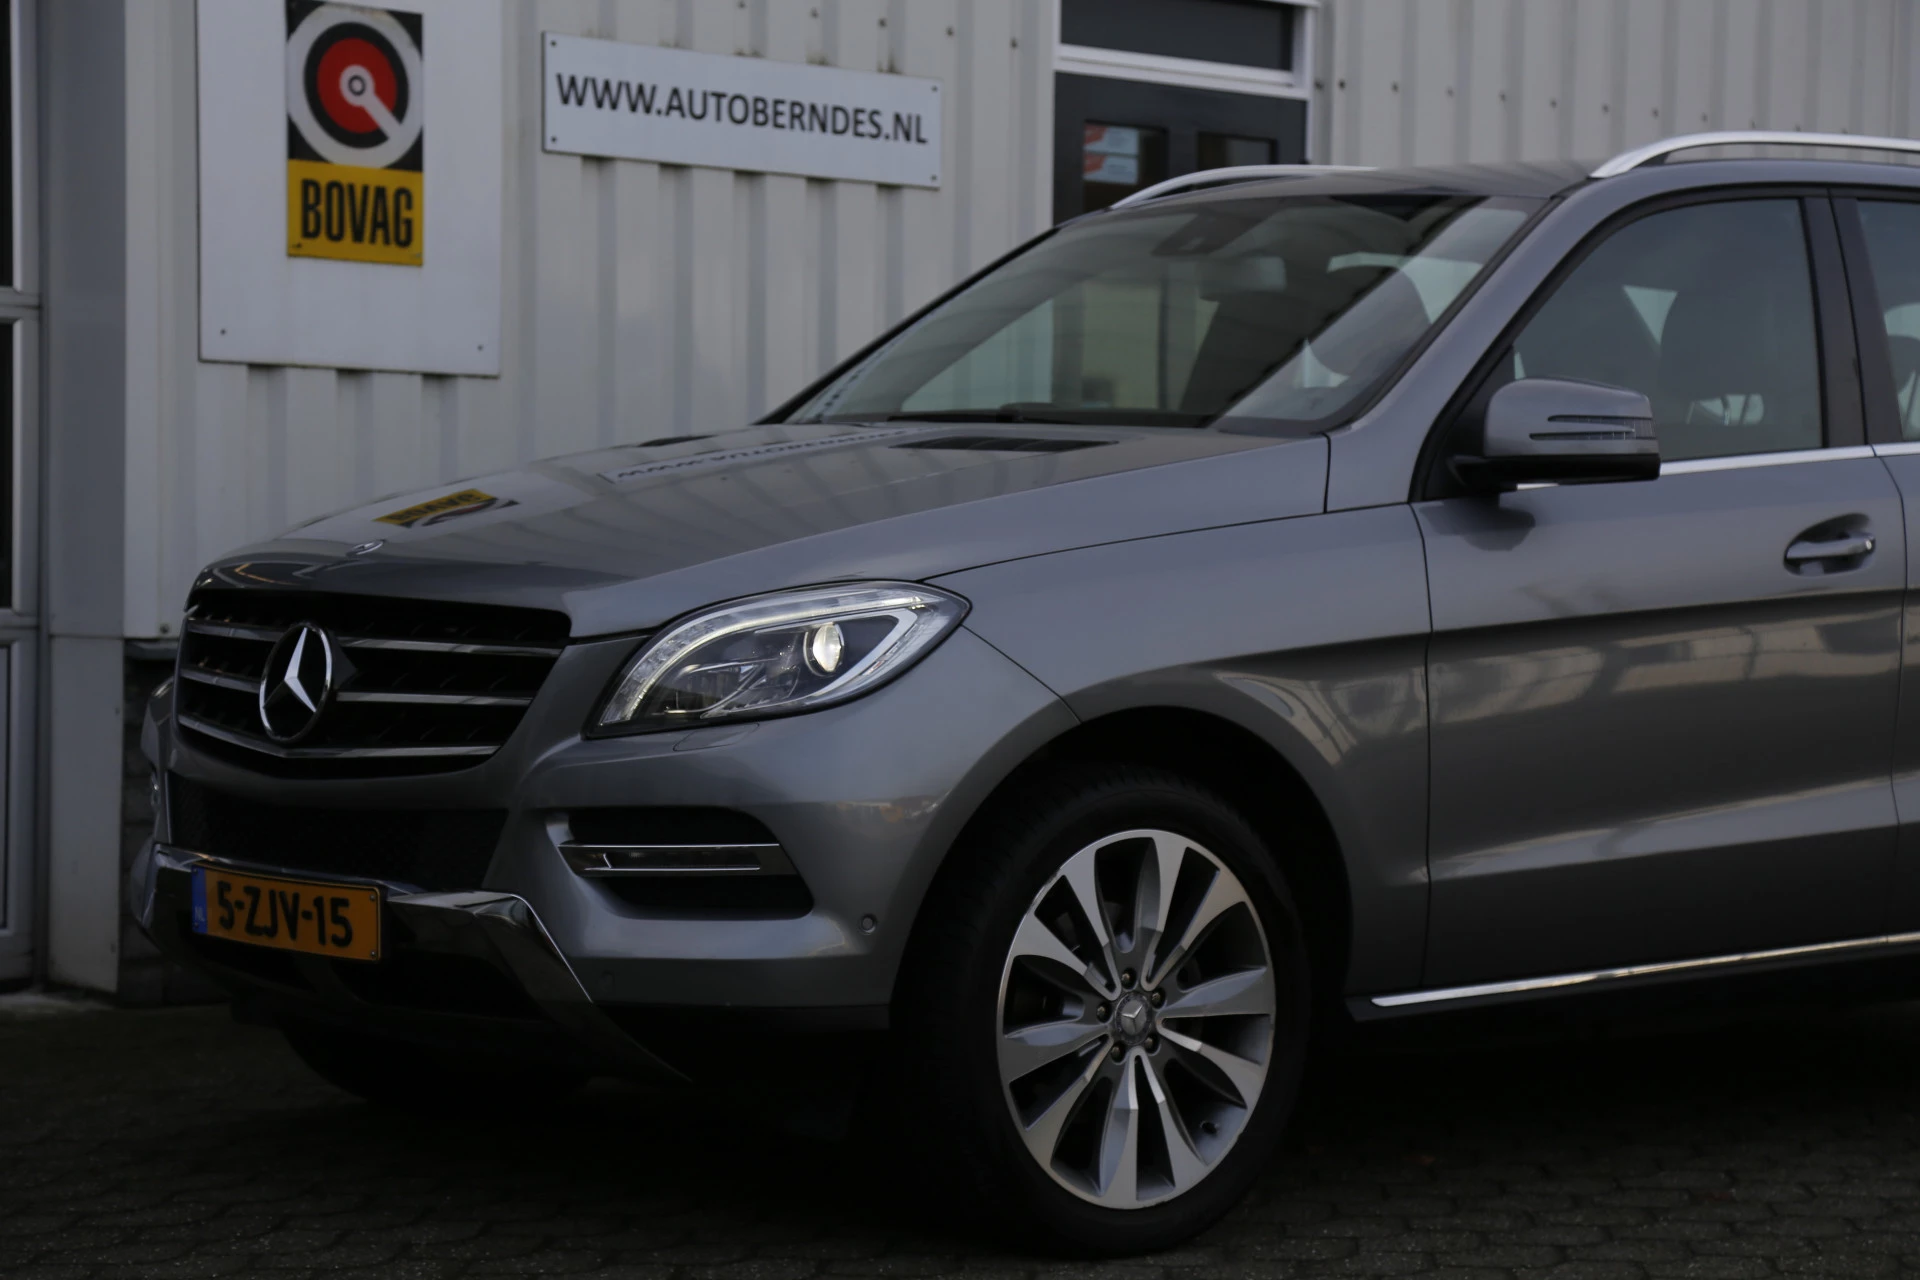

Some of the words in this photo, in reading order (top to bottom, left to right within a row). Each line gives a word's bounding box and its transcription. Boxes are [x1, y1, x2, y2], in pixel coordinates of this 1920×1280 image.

[556, 73, 928, 144] WWW.AUTOBERNDES.NL
[301, 178, 413, 249] BOVAG
[217, 880, 353, 947] 5-ZJV-15
